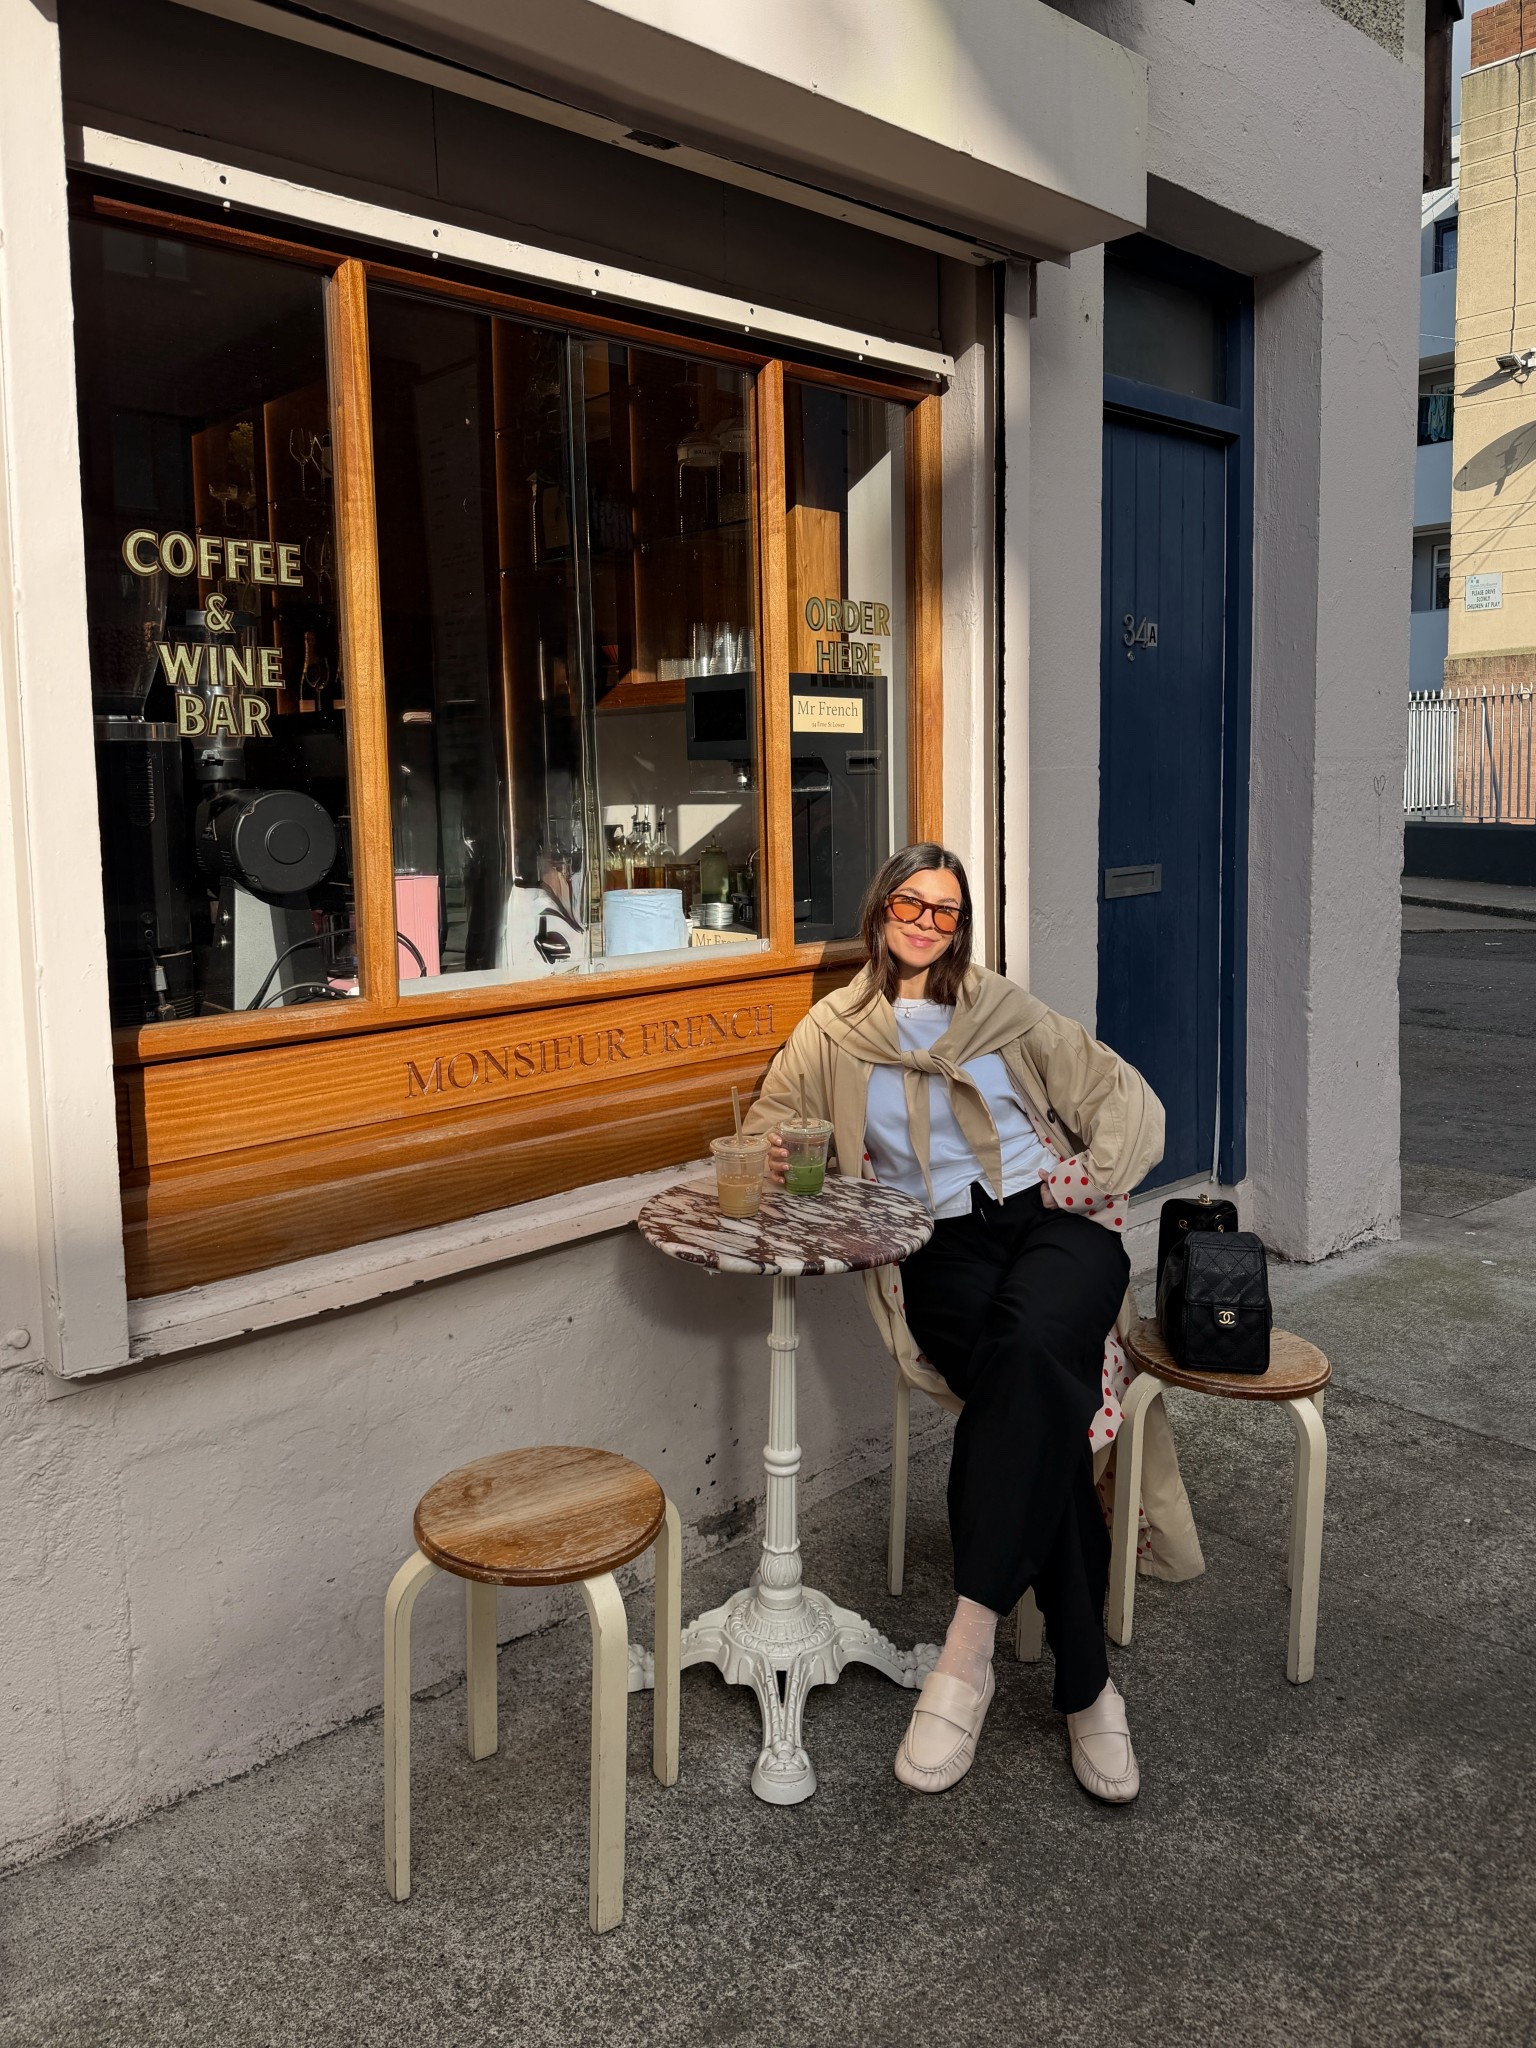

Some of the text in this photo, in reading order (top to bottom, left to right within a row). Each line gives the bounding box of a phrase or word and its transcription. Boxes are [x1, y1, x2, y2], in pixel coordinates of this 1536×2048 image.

[121, 529, 303, 587] COFFEE
[204, 593, 236, 633] &
[805, 596, 890, 636] ORDER
[1123, 613, 1158, 649] 34A
[154, 641, 286, 689] WINE
[816, 640, 882, 675] HERE
[176, 693, 272, 737] BAR
[797, 700, 859, 717] Mr French
[696, 933, 712, 946] Mr
[403, 1003, 775, 1099] MONSIEUR FRENCH
